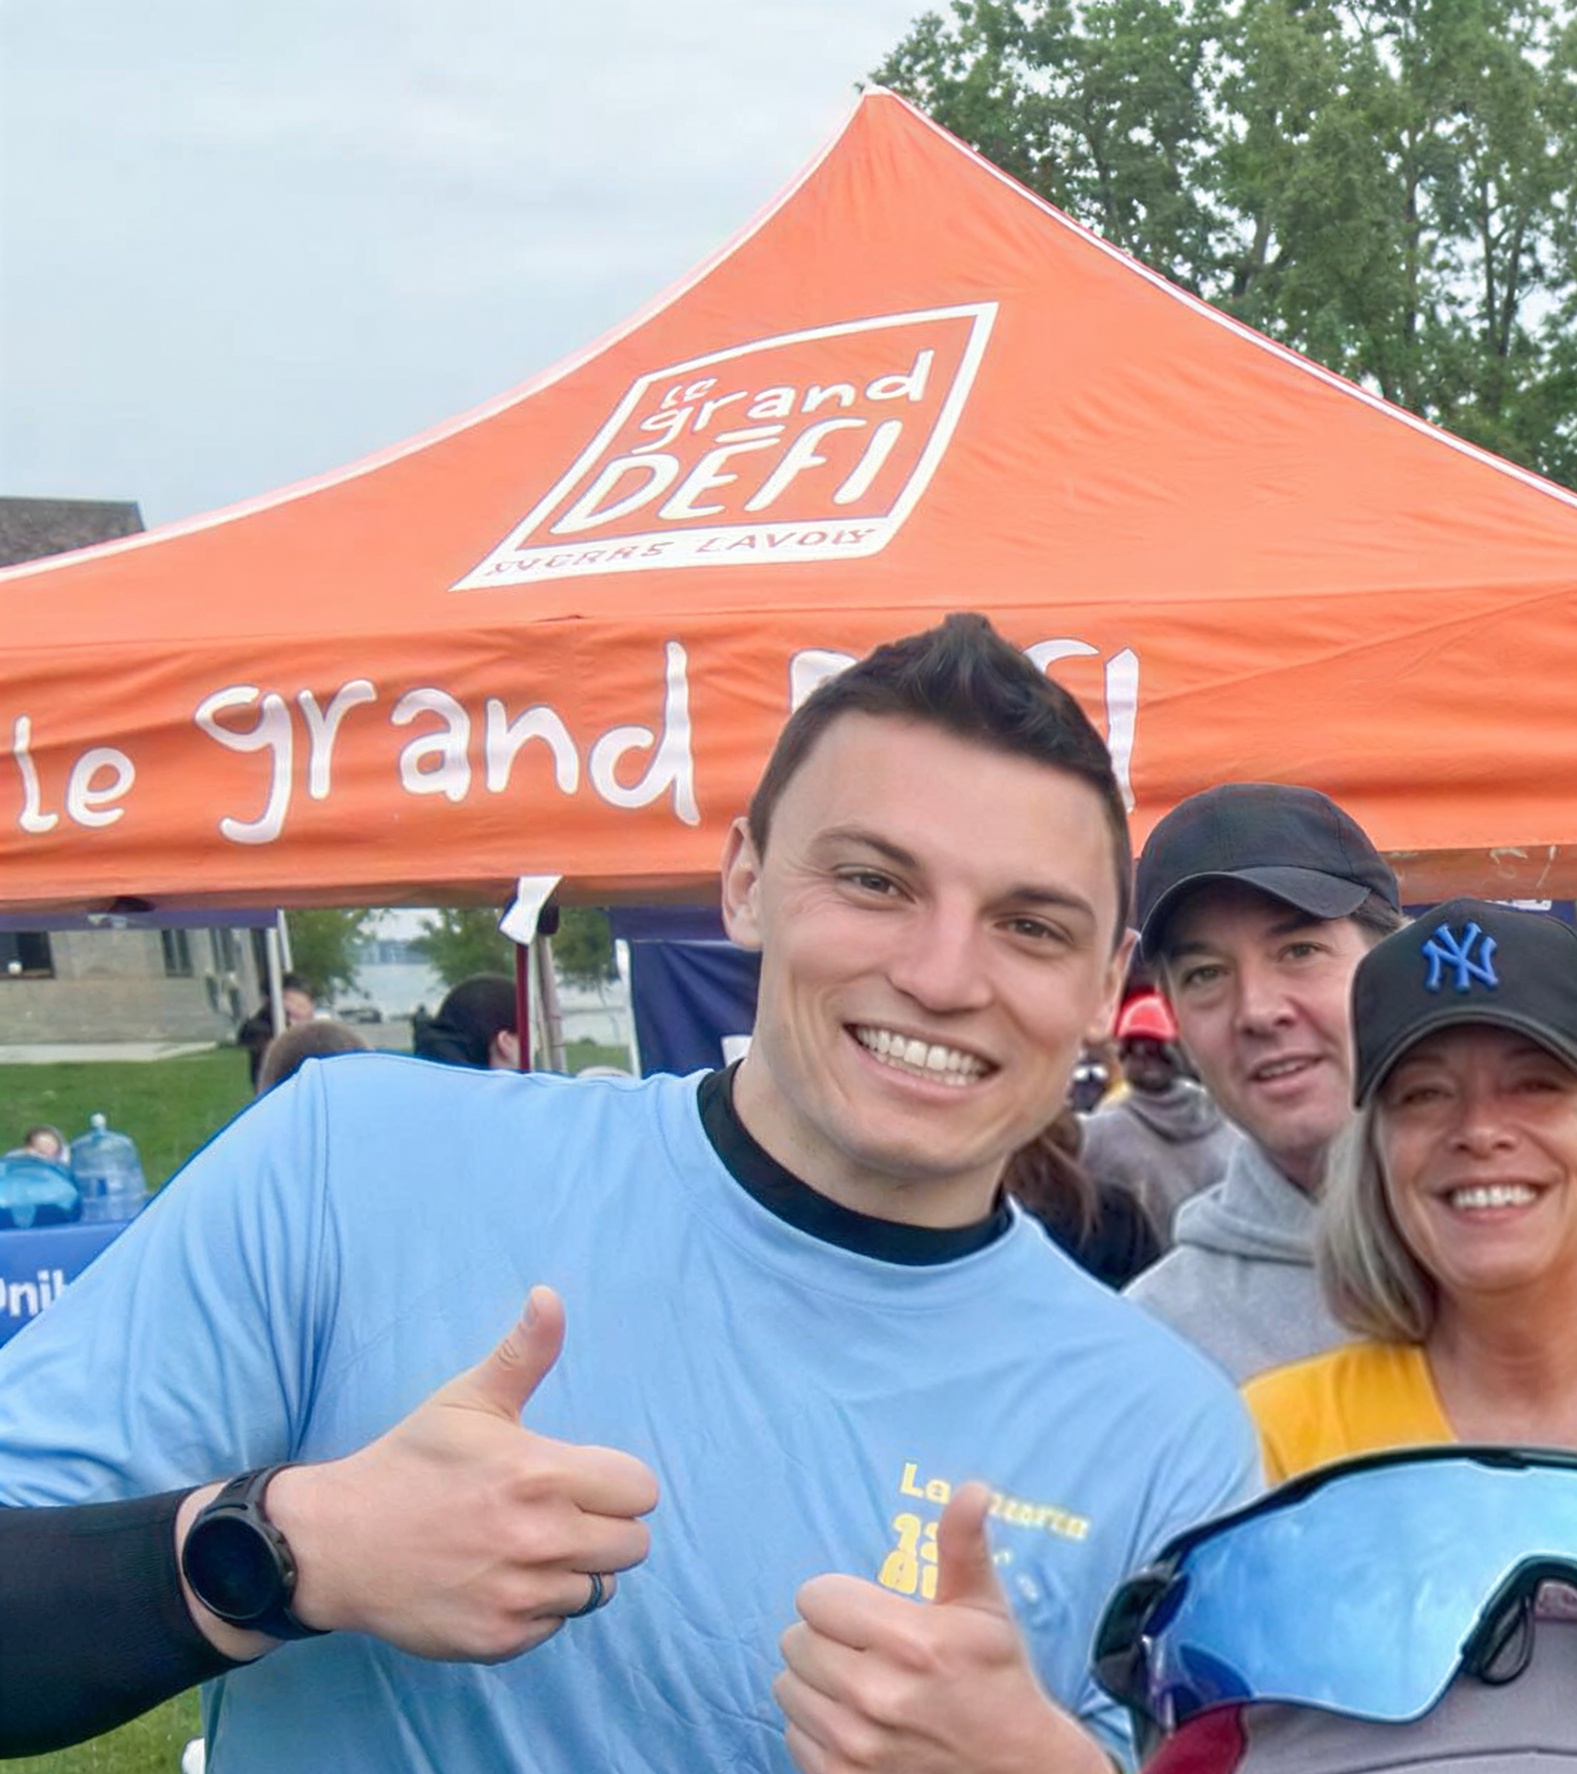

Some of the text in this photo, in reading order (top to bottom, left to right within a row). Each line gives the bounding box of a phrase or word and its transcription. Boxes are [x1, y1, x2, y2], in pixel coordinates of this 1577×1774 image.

[631, 349, 935, 455] grand
[549, 416, 904, 535] DÉFI
[194, 638, 702, 846] grand
[1420, 920, 1499, 994] NY
